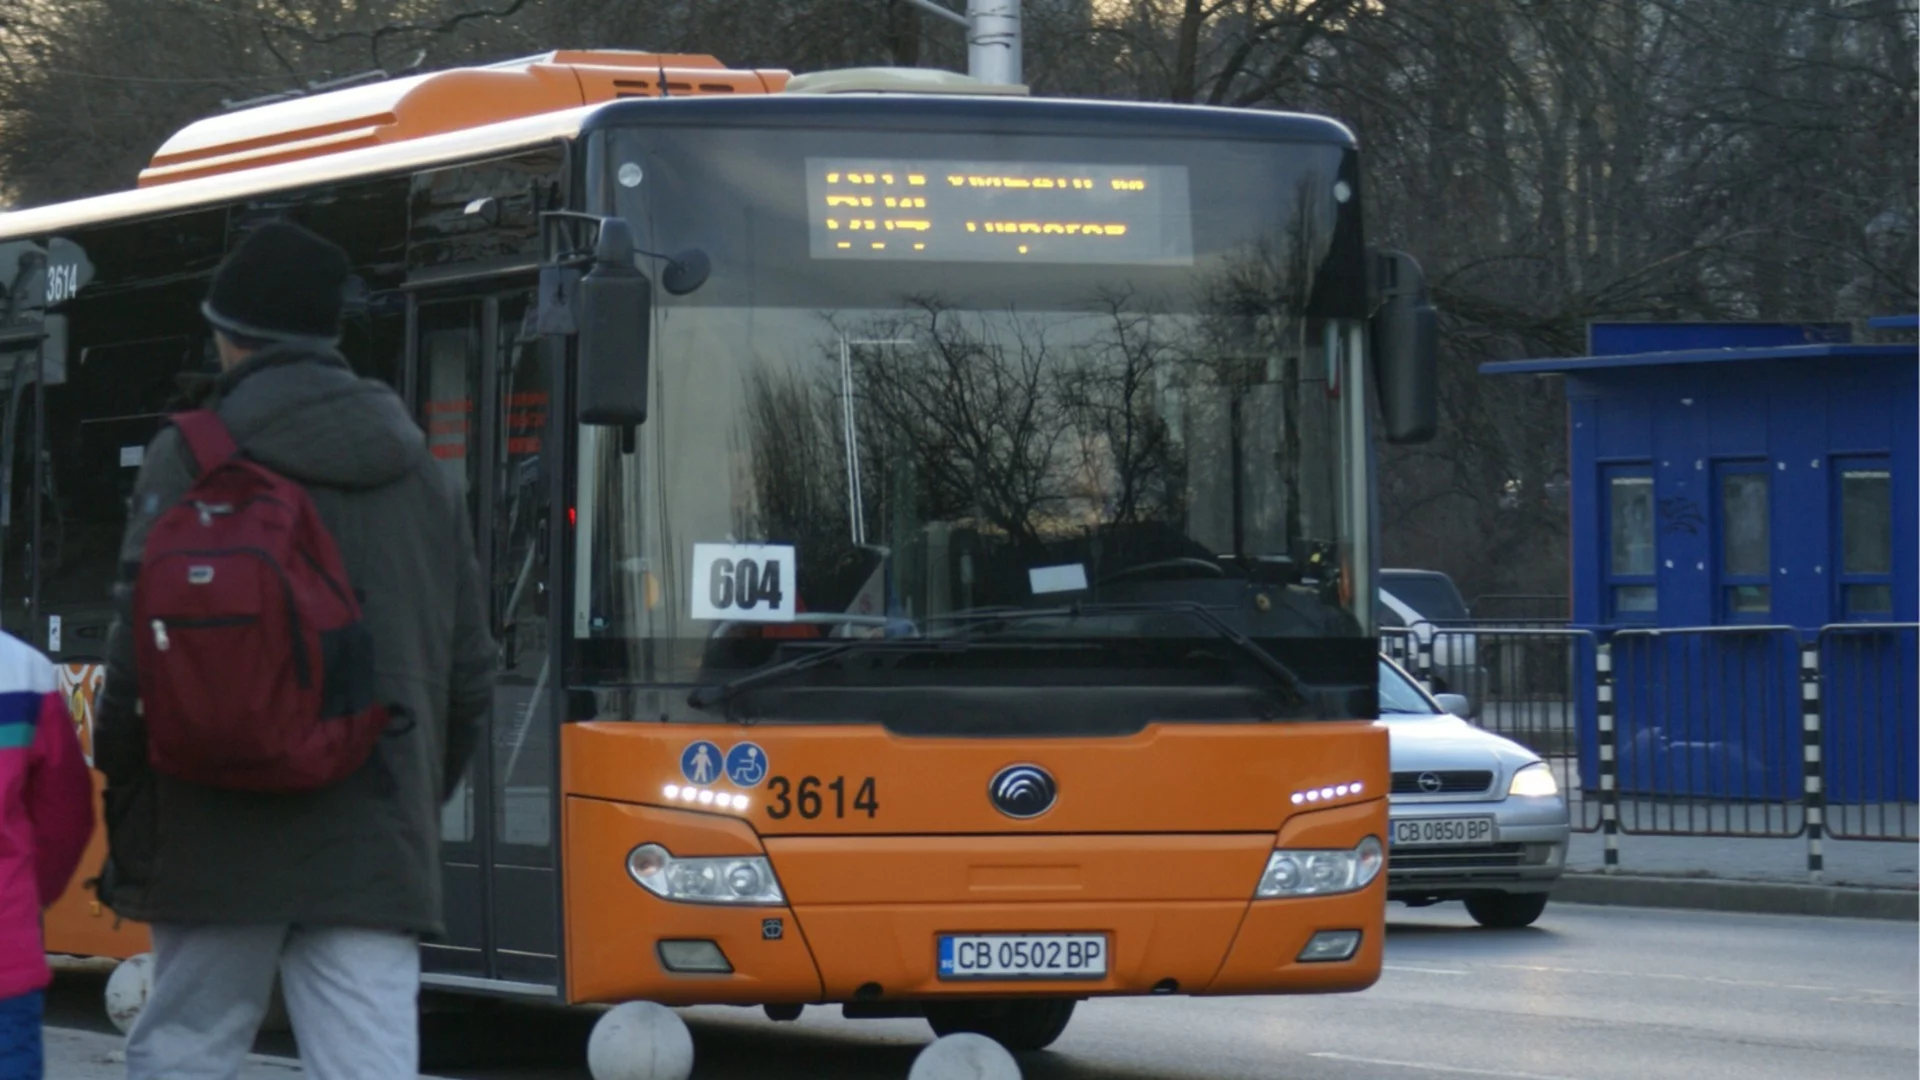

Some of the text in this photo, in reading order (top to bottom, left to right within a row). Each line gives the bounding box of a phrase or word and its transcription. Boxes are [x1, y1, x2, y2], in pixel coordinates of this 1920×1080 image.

[46, 263, 78, 301] 3614
[709, 557, 783, 610] 604
[766, 775, 879, 820] 3614
[1397, 820, 1490, 841] CB 0850 BP
[958, 940, 1101, 969] CB 0502 BP
